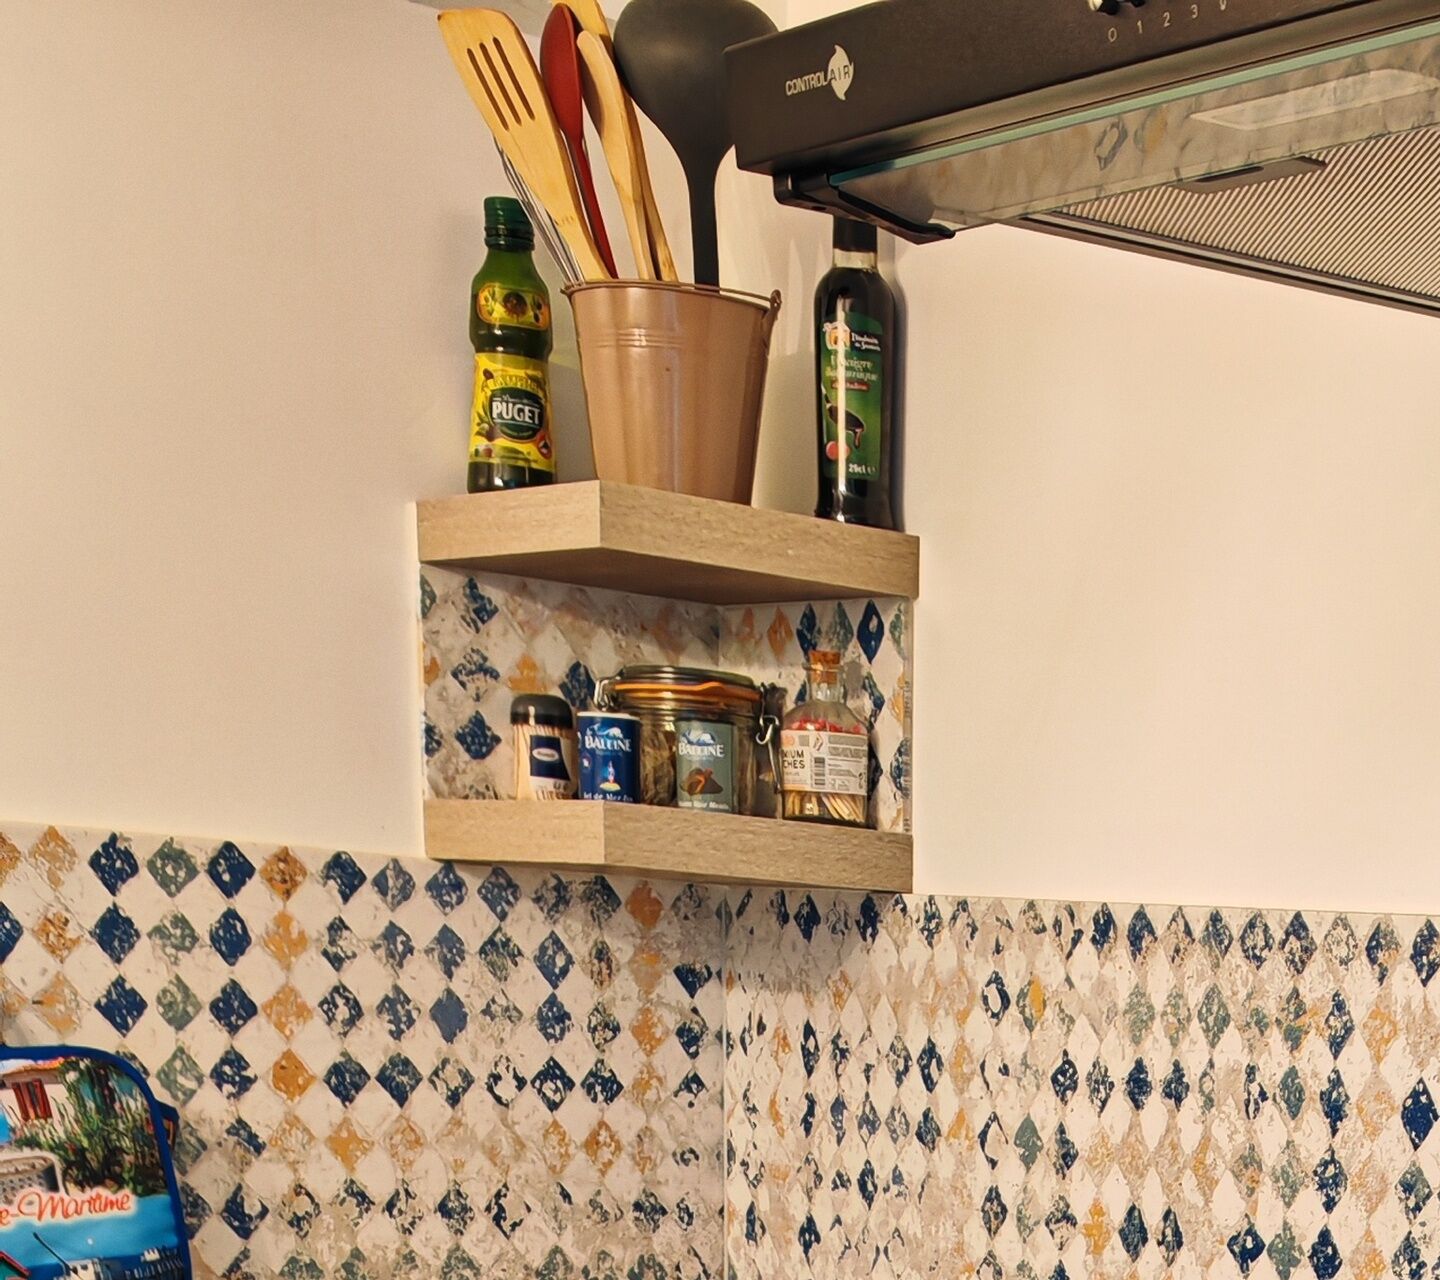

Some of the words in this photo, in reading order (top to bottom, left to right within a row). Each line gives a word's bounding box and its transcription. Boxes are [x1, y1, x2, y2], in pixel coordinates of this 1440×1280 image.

[1162, 11, 1171, 28] 2
[1190, 4, 1199, 19] 3
[491, 401, 542, 425] PUGET
